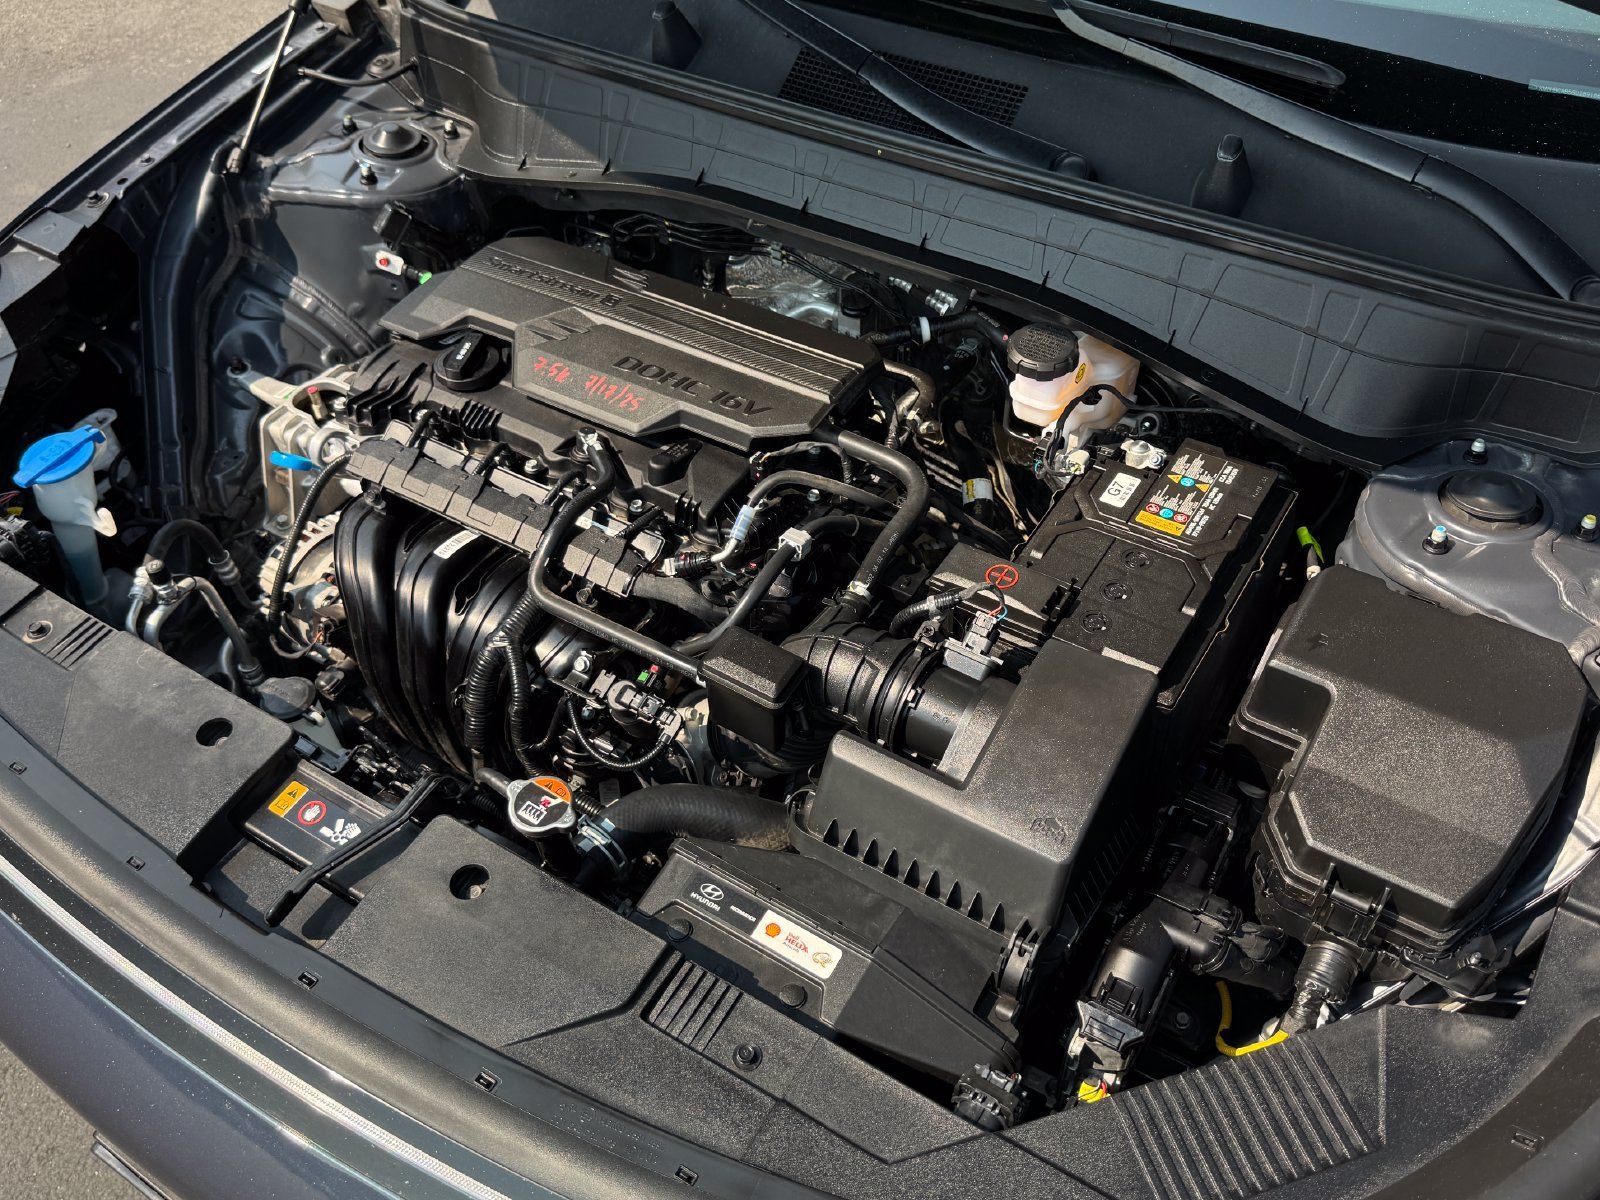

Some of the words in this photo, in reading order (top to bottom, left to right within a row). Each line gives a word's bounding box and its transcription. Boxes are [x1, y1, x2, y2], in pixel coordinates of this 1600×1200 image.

[485, 256, 600, 298] Smartstream
[612, 356, 711, 396] DOHC
[708, 389, 774, 417] 16V
[1108, 481, 1124, 496] G7
[690, 891, 721, 912] HYUNDAI
[785, 935, 808, 953] HELIX
